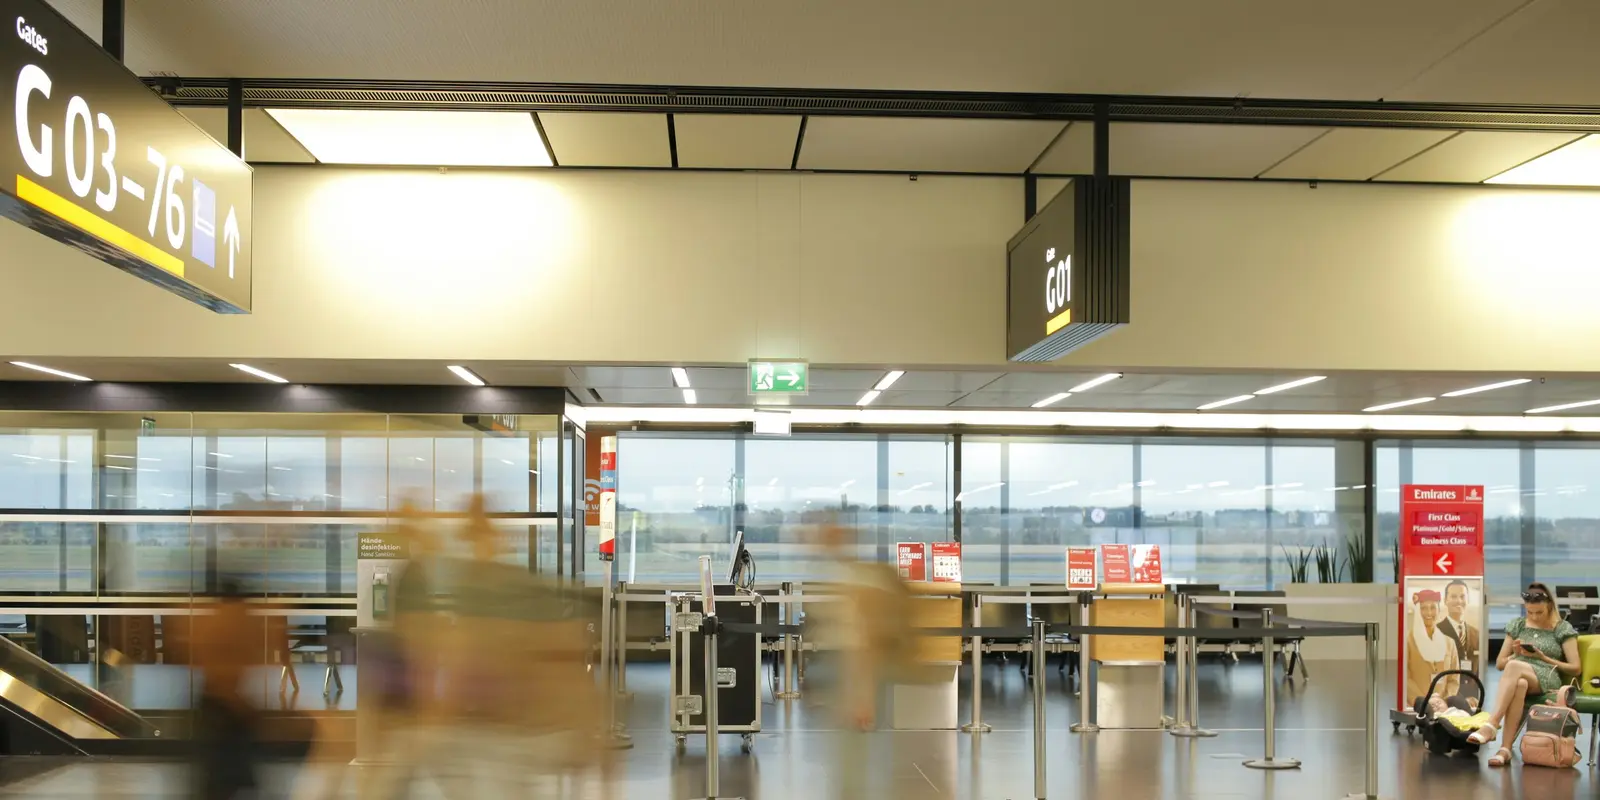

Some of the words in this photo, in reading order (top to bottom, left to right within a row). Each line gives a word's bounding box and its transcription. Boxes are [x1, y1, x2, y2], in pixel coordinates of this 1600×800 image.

[16, 16, 48, 56] Gates
[1414, 488, 1457, 500] Emirates
[1428, 513, 1443, 522] First
[1444, 513, 1461, 522] Class
[1421, 537, 1449, 545] Business
[1449, 537, 1467, 545] Class
